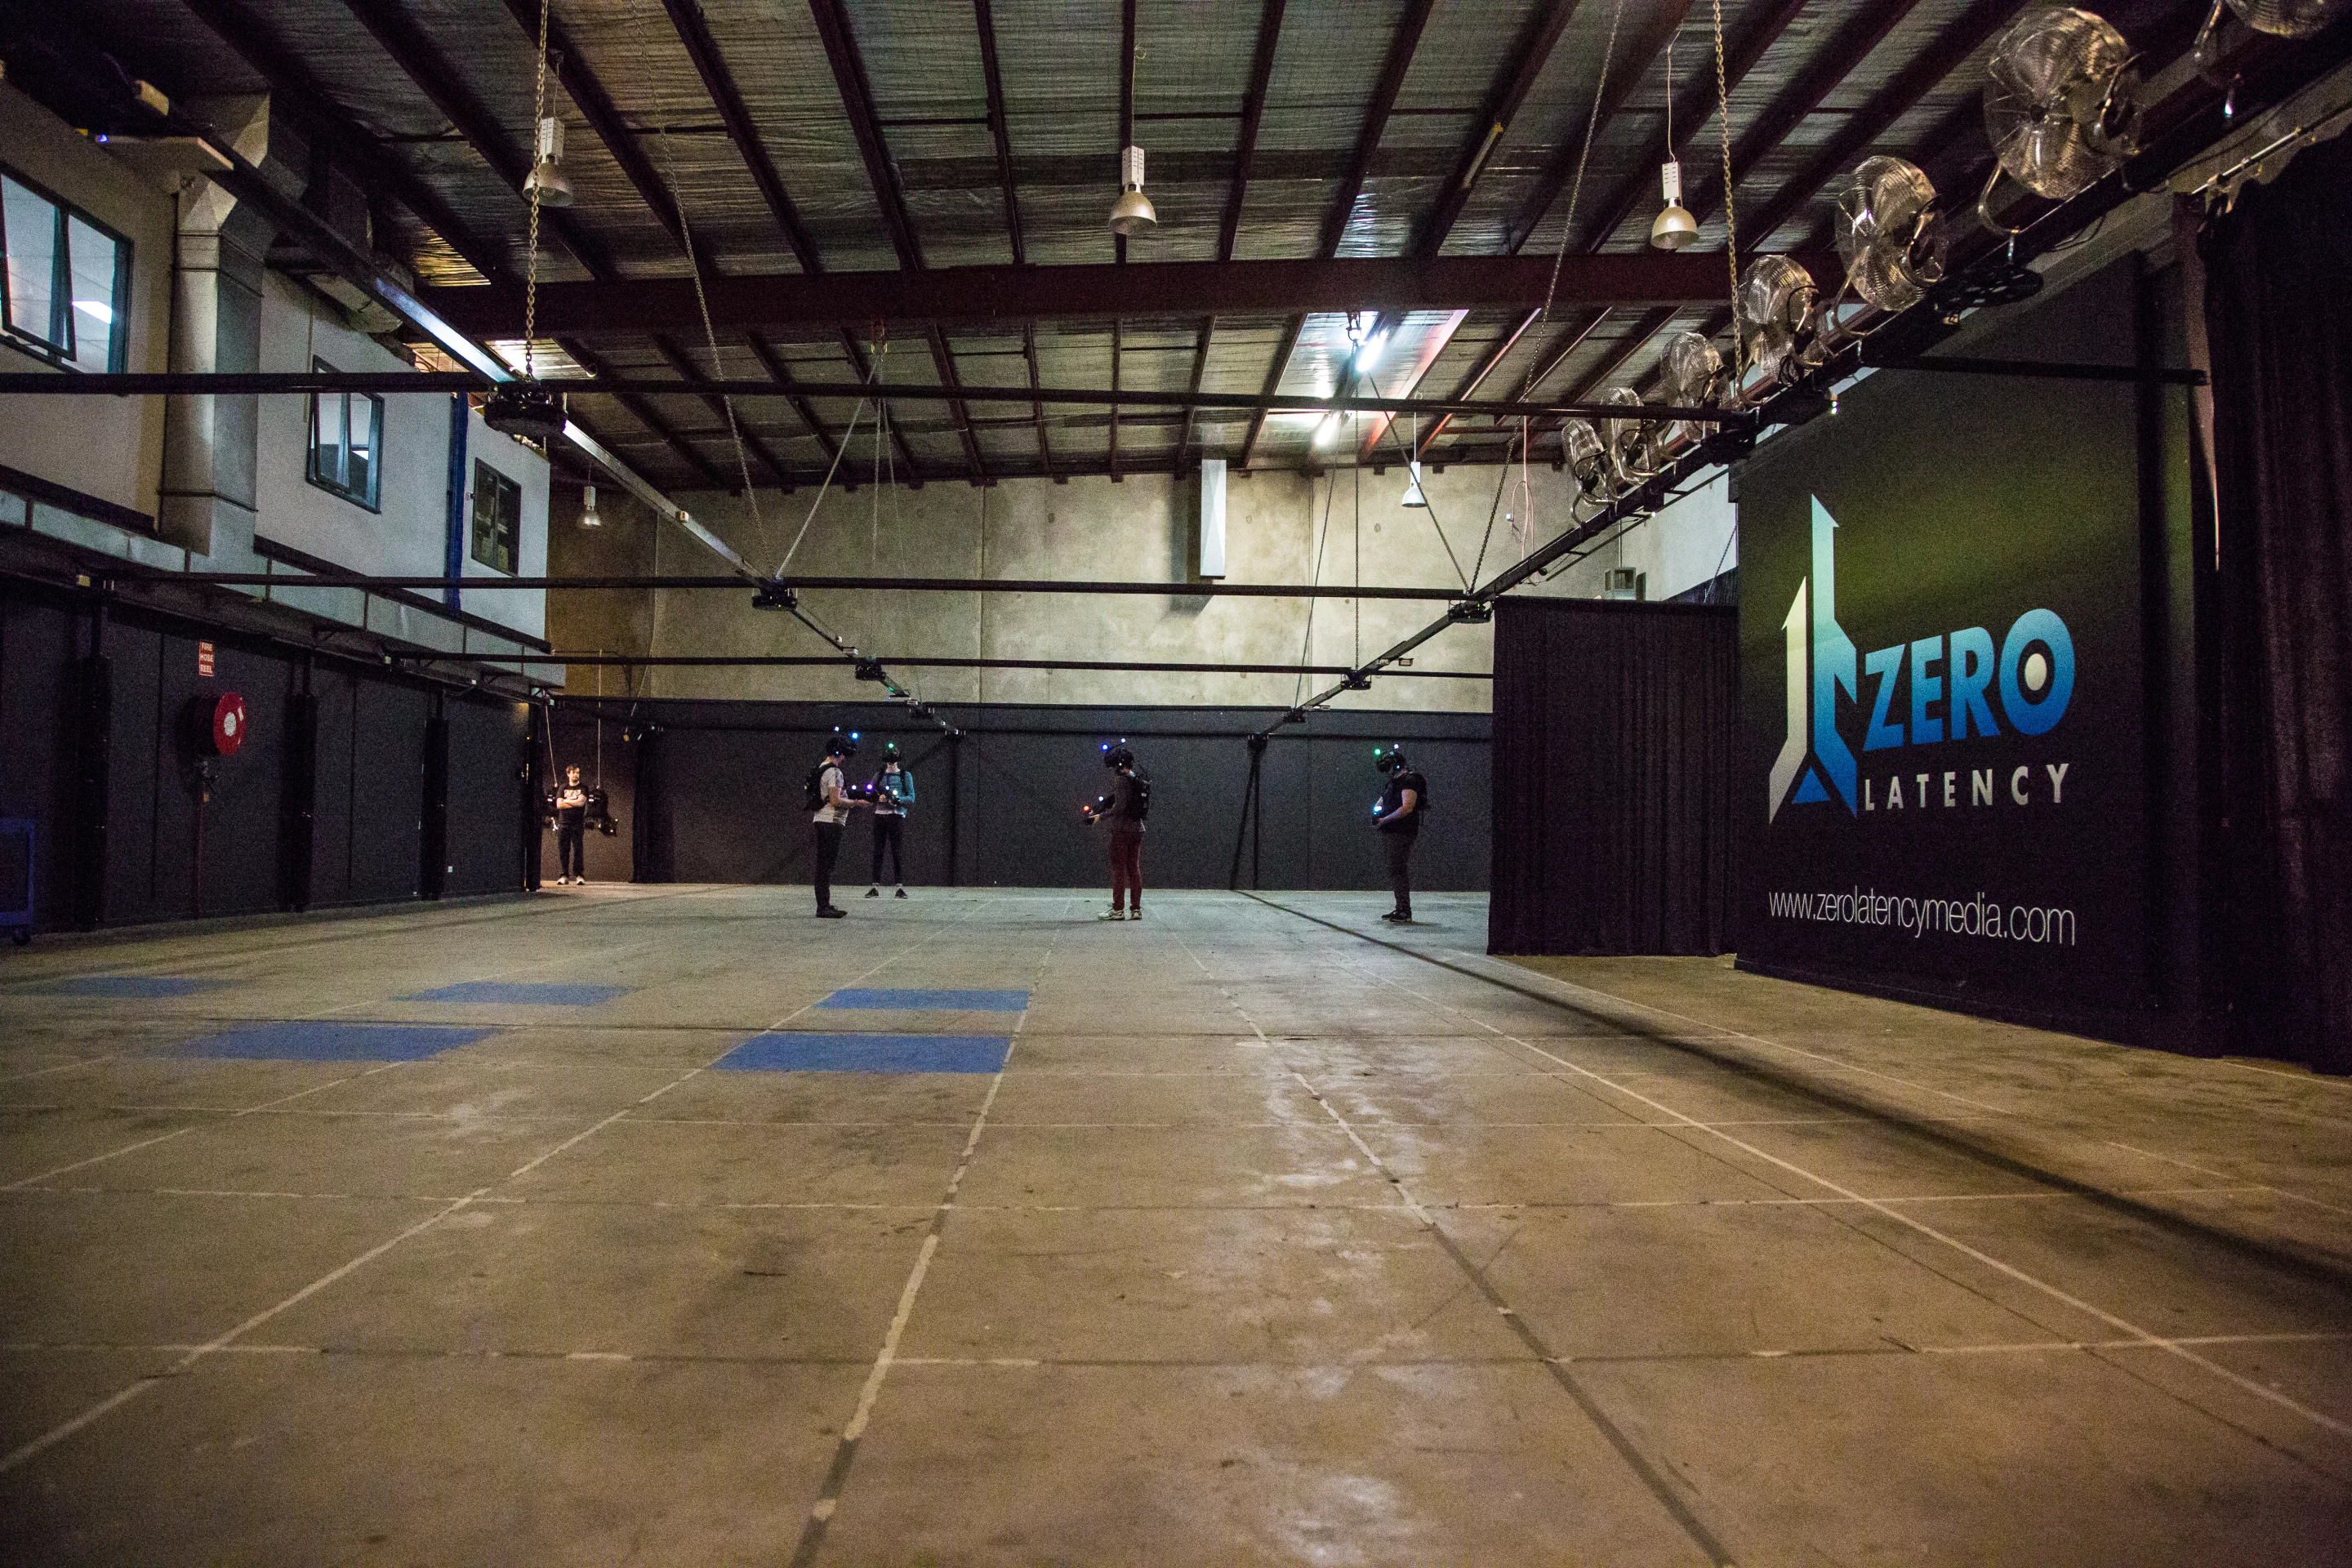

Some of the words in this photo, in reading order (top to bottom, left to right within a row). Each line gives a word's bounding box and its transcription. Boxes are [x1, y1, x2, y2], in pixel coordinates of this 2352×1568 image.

[200, 653, 213, 662] HOSE
[201, 642, 212, 651] FIRE
[200, 664, 212, 673] REEL
[1863, 608, 2075, 751] ZERO
[1864, 763, 2069, 811] LATENCY
[1769, 885, 2075, 946] www.zerolatencymedia.com
